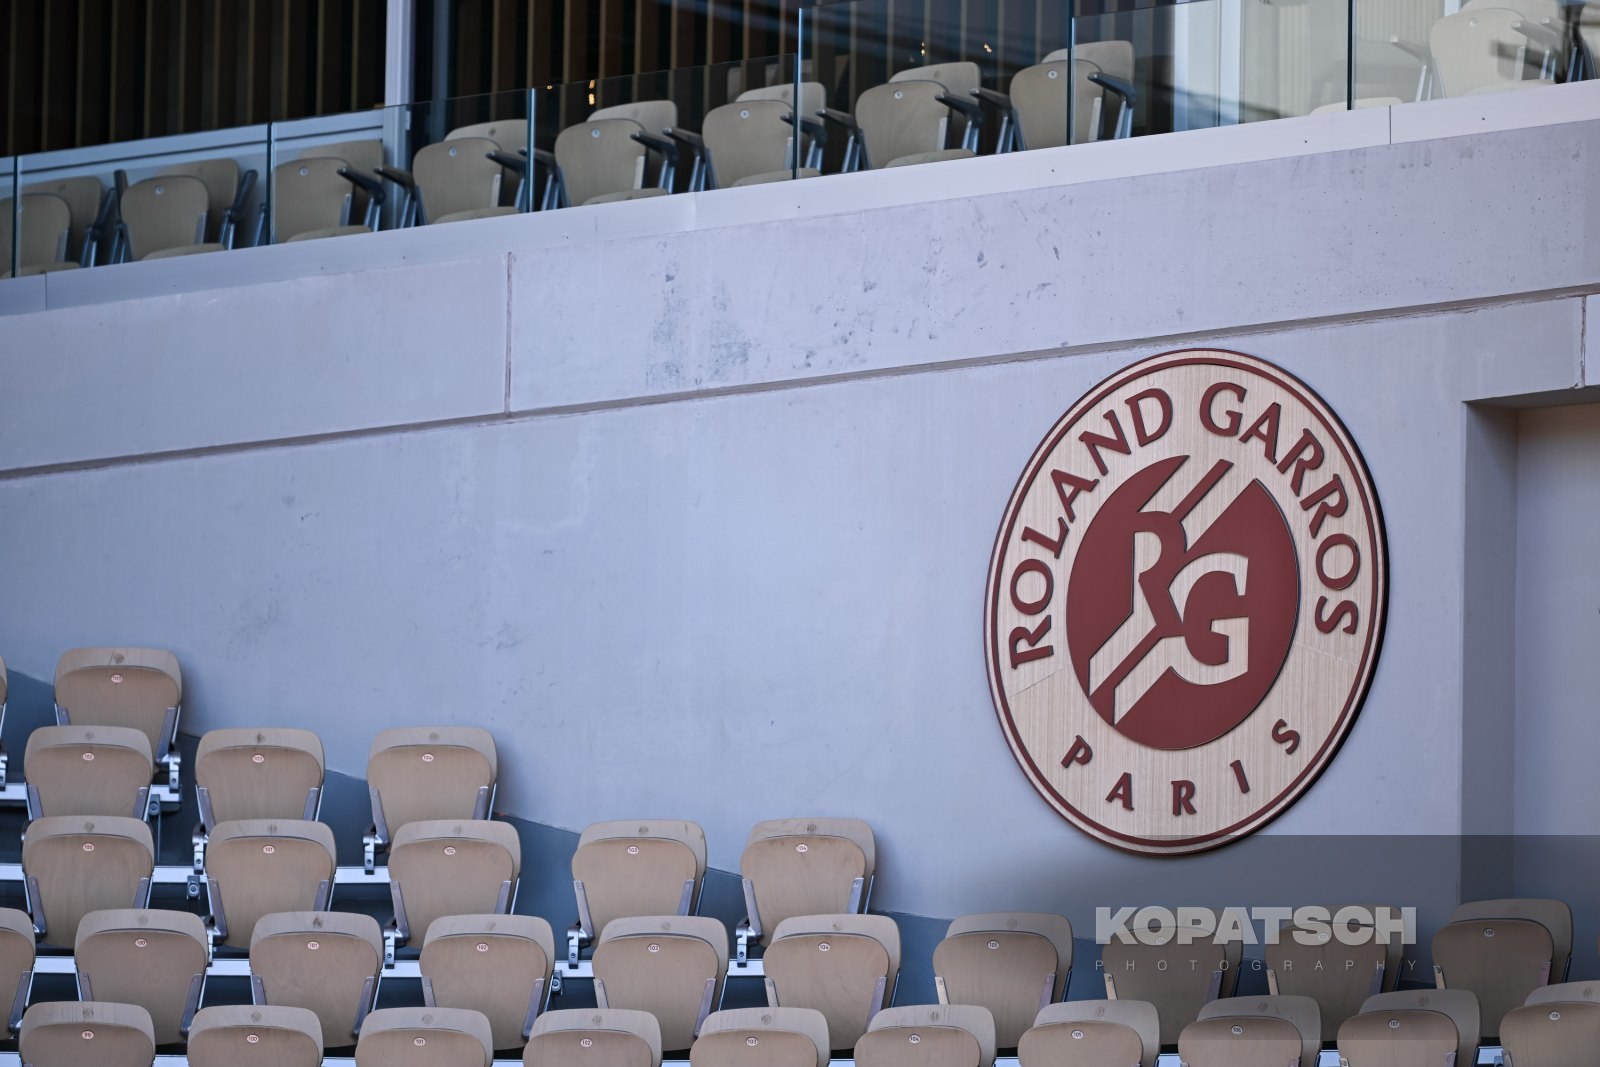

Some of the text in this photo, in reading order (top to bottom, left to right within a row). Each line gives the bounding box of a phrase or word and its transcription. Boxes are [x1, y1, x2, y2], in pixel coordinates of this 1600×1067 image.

[1009, 381, 1361, 670] ROLAND GARROS
[1060, 717, 1301, 817] PARIS
